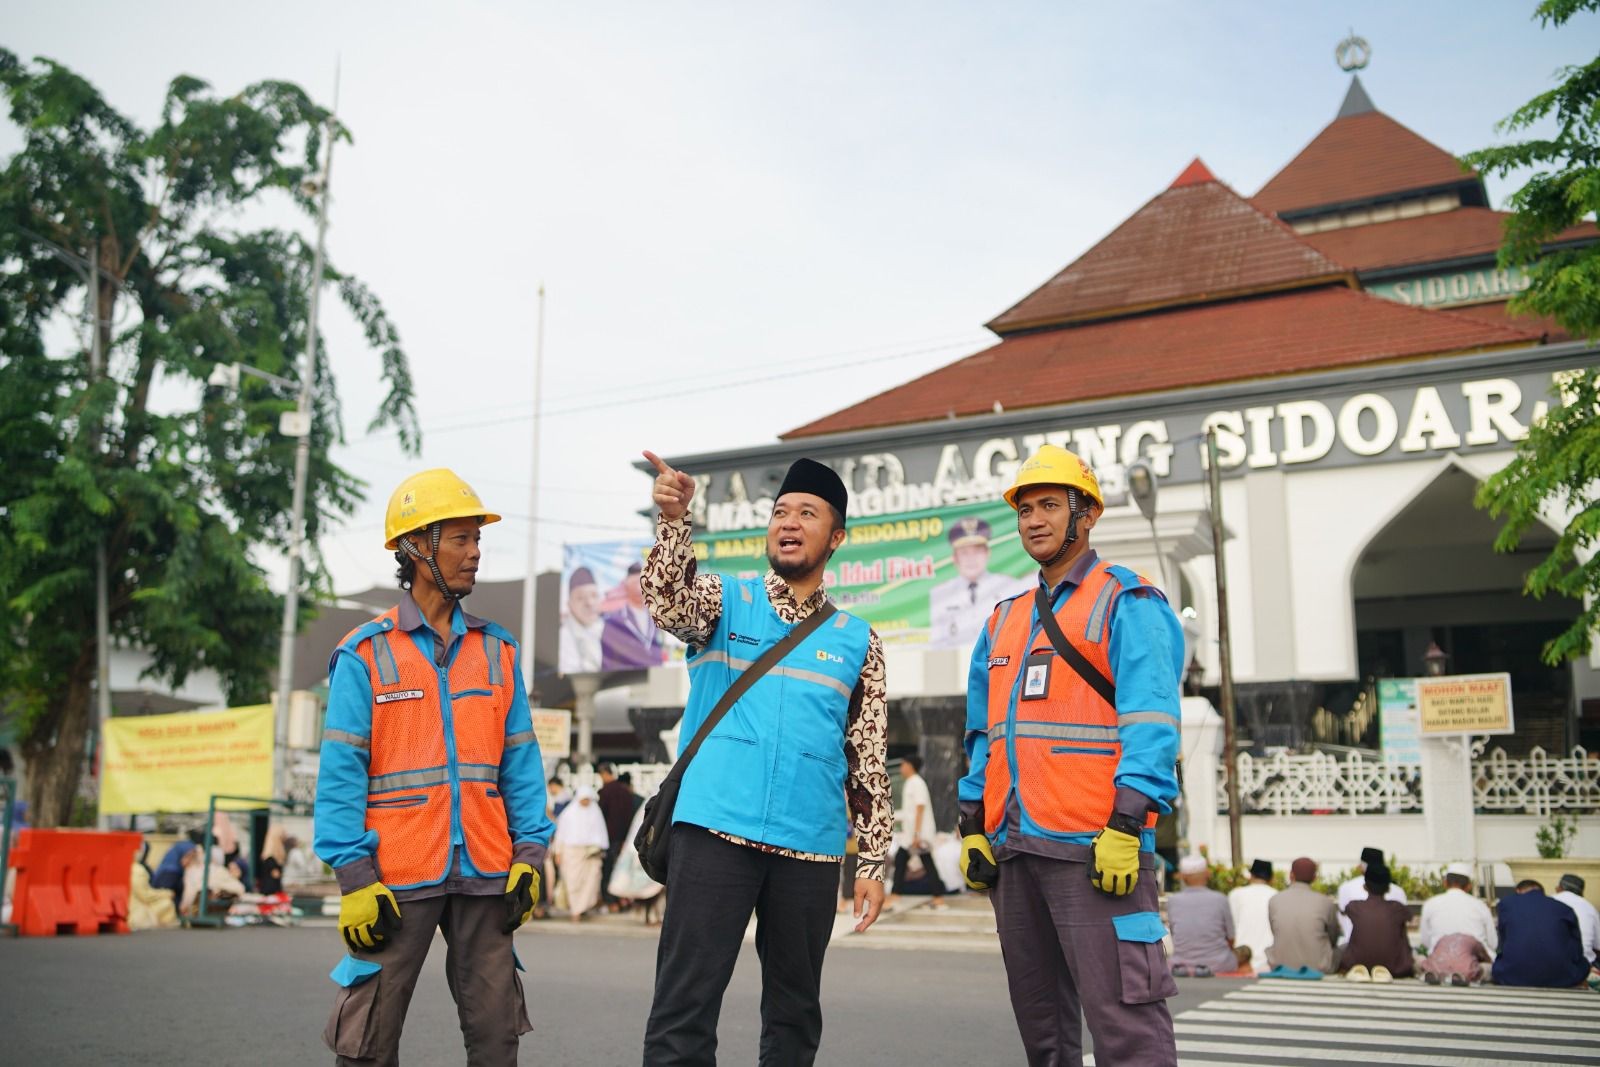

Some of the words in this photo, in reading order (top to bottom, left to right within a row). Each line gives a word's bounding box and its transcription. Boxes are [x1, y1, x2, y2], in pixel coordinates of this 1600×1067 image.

[851, 517, 943, 545] SIDOARJO
[840, 562, 883, 587] Idul
[885, 556, 934, 581] Fitri
[827, 653, 844, 663] PLN
